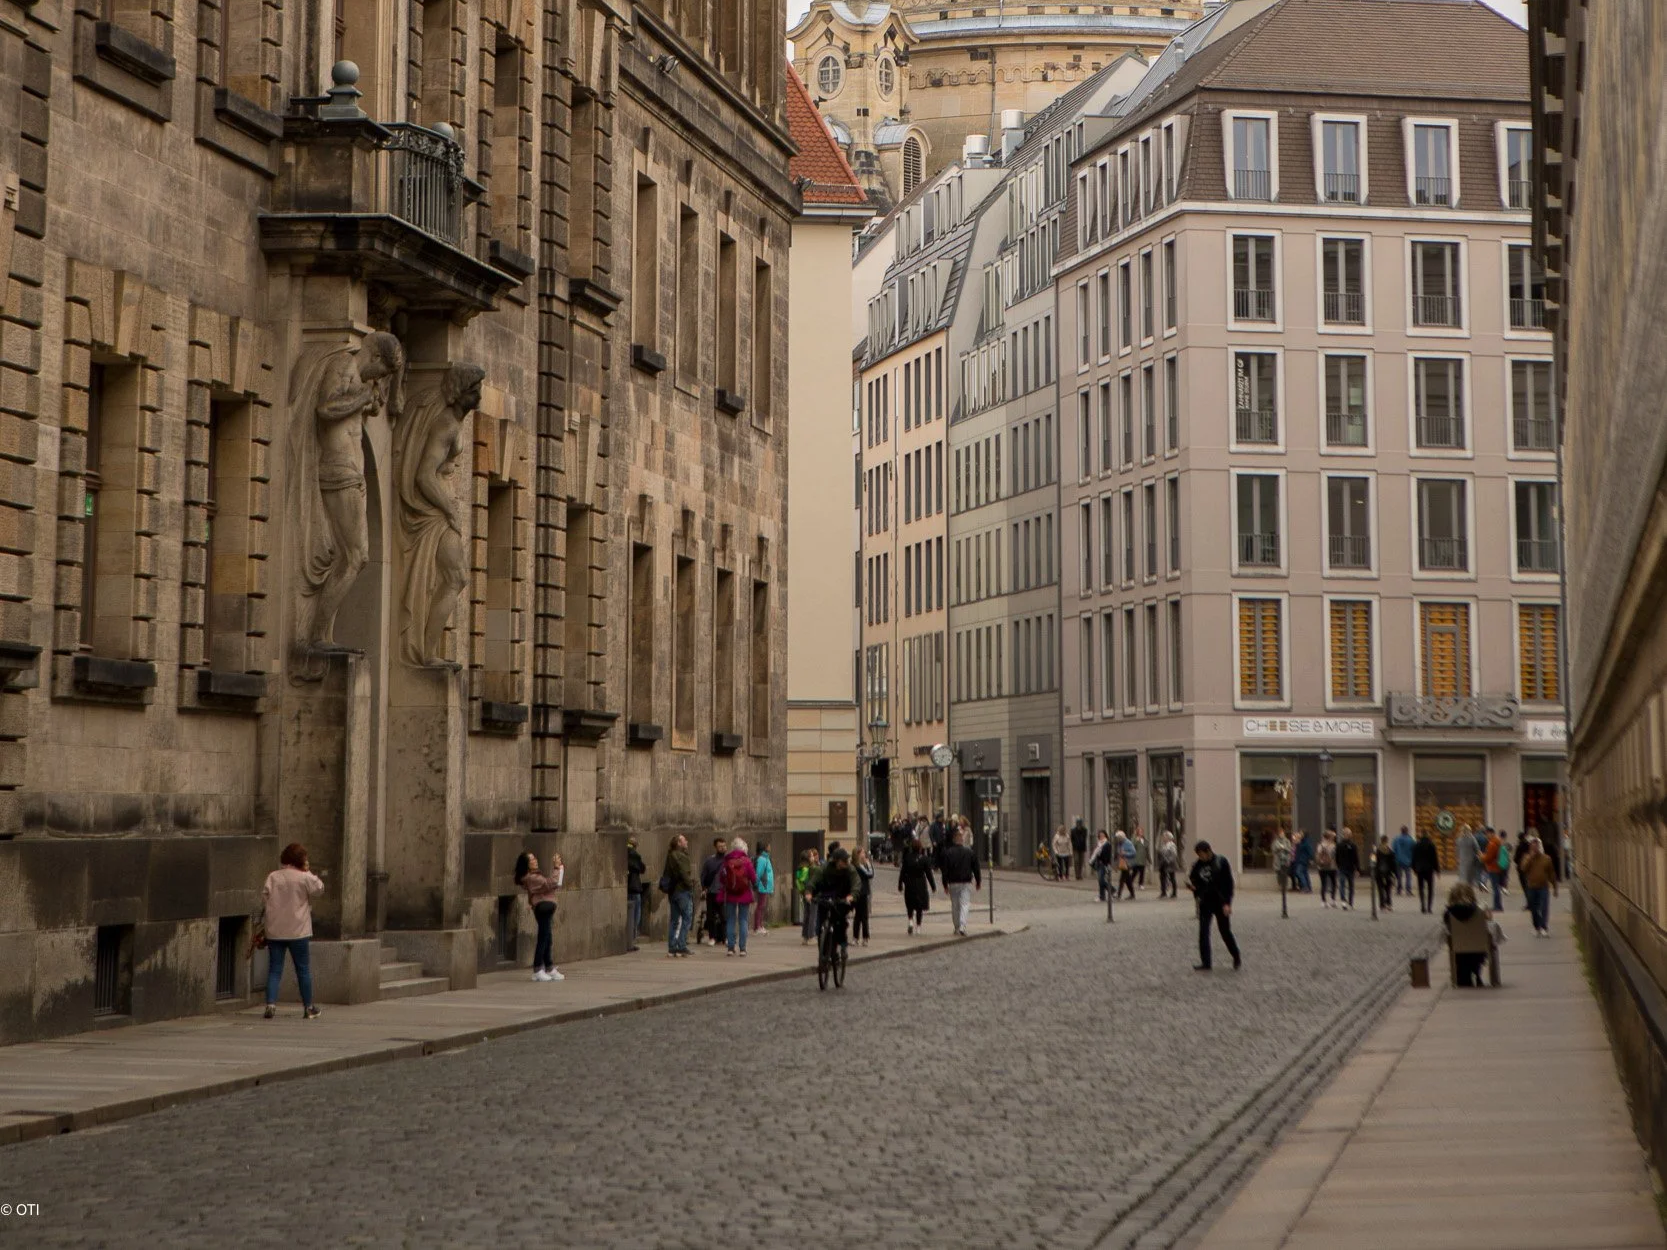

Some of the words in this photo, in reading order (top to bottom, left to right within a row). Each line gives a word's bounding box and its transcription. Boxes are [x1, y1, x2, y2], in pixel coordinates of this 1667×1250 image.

[1245, 719, 1310, 732] CHEESE
[1312, 720, 1323, 733] &
[1325, 721, 1372, 734] MORE
